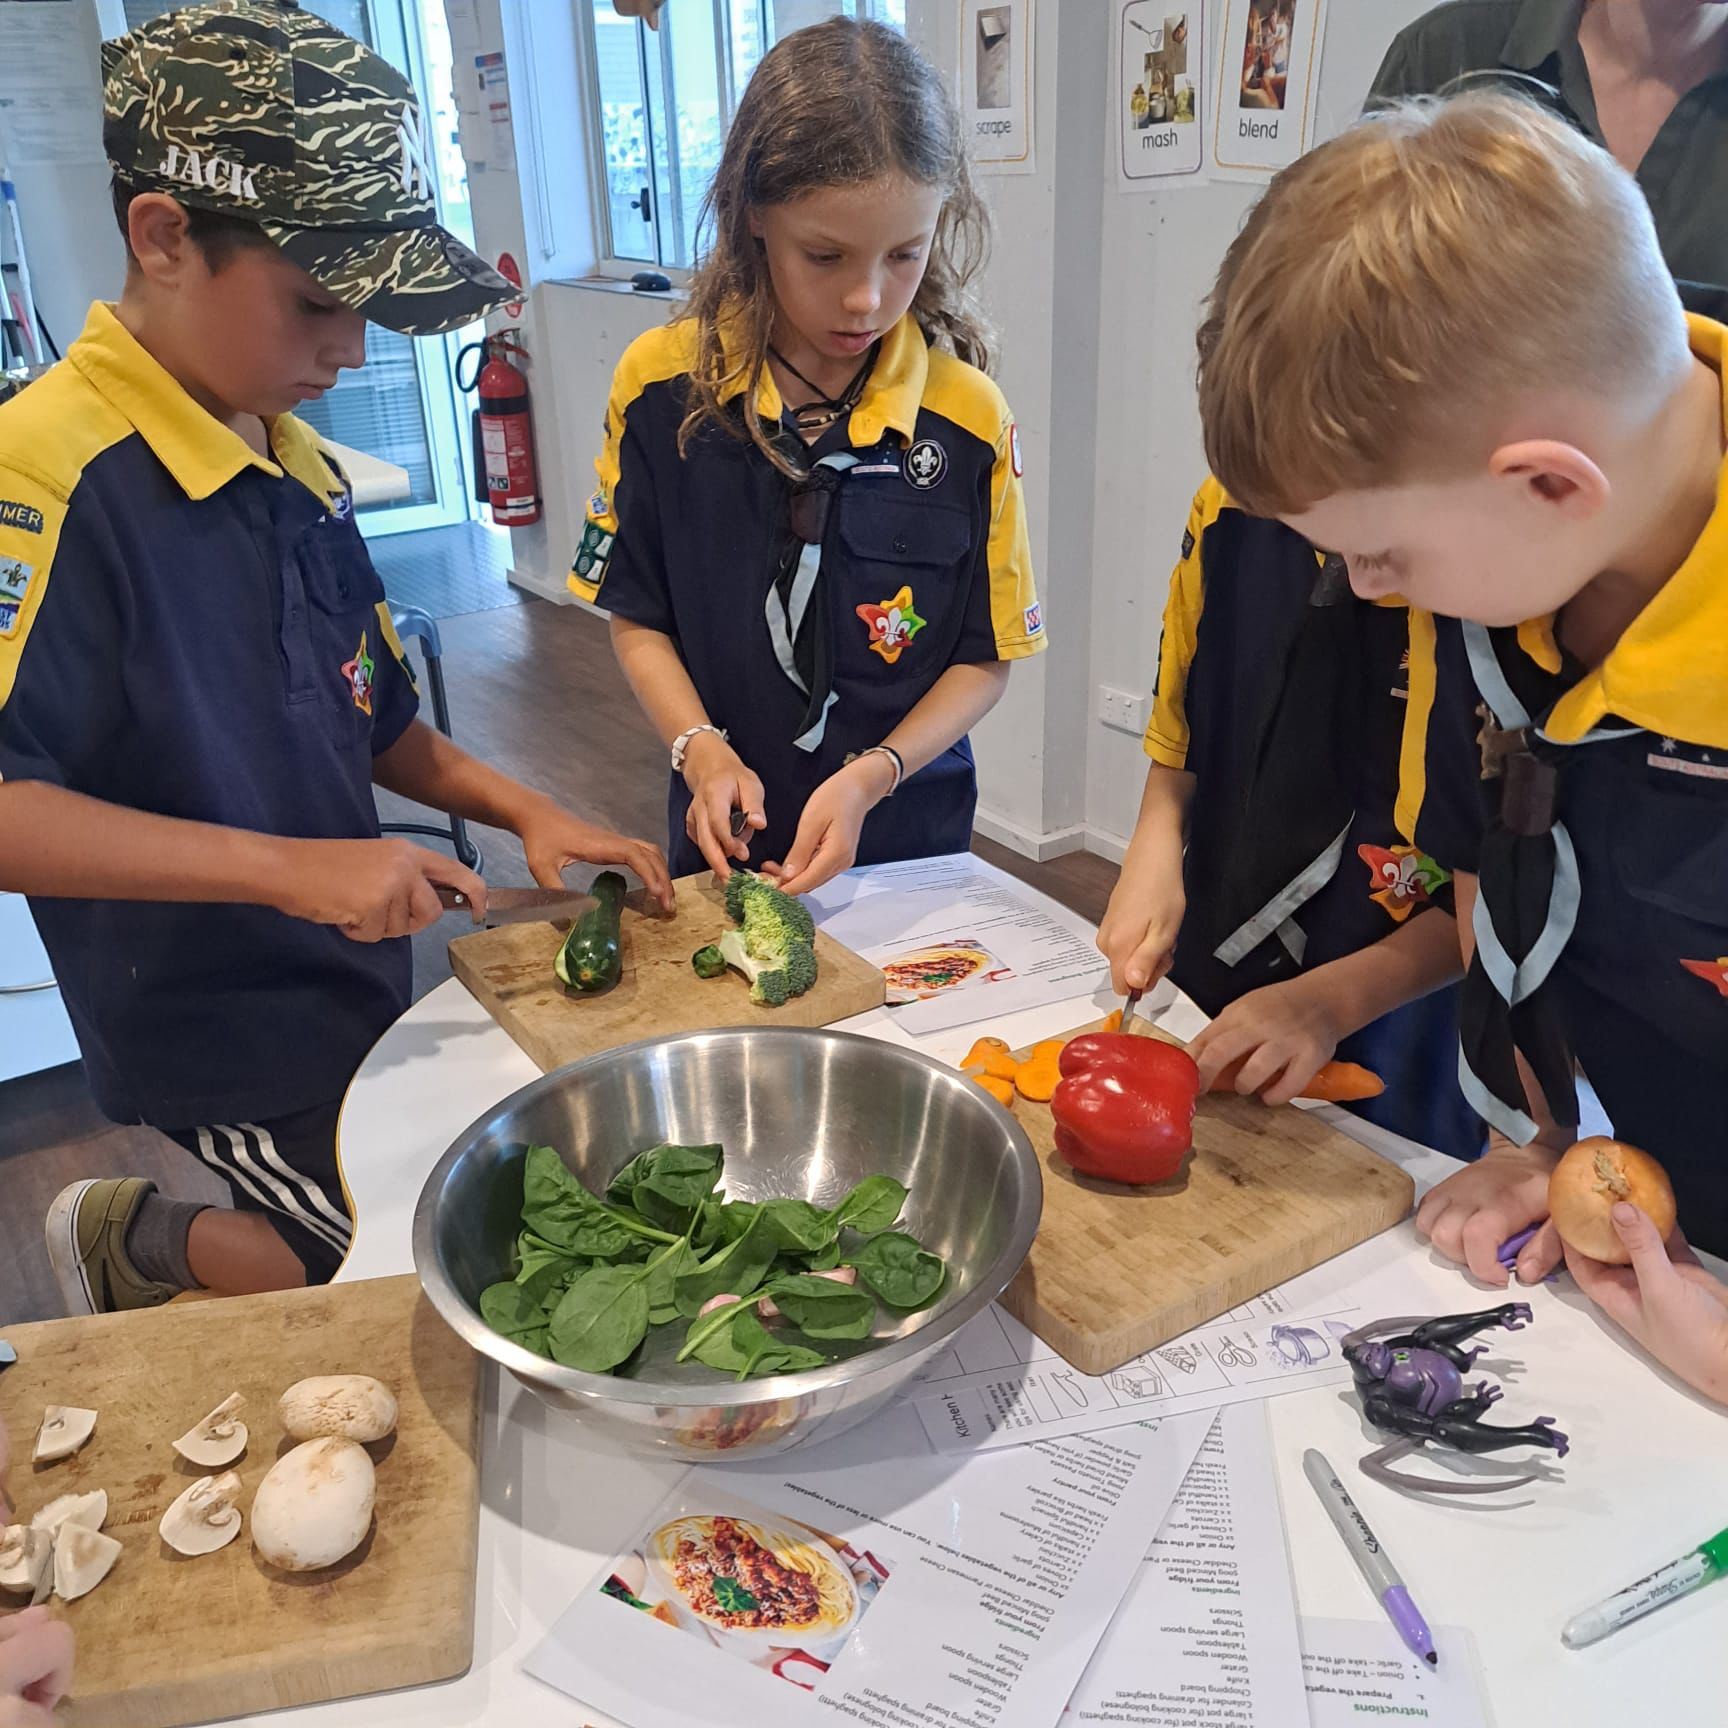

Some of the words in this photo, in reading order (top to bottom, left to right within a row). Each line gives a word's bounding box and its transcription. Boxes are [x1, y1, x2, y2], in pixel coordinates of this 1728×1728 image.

[976, 120, 1011, 138] scrape
[1238, 118, 1278, 140] blend
[1142, 128, 1178, 149] mash
[159, 144, 259, 200] JACK
[0, 503, 42, 527] MER
[946, 1401, 971, 1438] Kitchen
[1061, 1445, 1076, 1455] you
[1064, 1456, 1085, 1468] herbs
[1077, 1469, 1105, 1484] Tomato
[1110, 1465, 1132, 1478] Garlic
[1051, 1475, 1078, 1491] pantry
[782, 1479, 824, 1501] vegetables!
[1025, 1483, 1052, 1500] parsley
[1077, 1485, 1096, 1497] your
[1100, 1487, 1120, 1499] Olive
[823, 1497, 837, 1507] the
[836, 1502, 845, 1510] of
[1034, 1497, 1065, 1513] Broccoli
[1052, 1495, 1066, 1505] like
[1095, 1494, 1117, 1506] From
[845, 1506, 860, 1516] less
[1029, 1503, 1060, 1521] Spinach
[1064, 1509, 1073, 1517] of
[1065, 1501, 1087, 1513] herbs
[1184, 1507, 1218, 1515] Zucchini
[868, 1515, 888, 1526] more
[1073, 1512, 1093, 1524] head
[1087, 1509, 1108, 1521] Fresh
[888, 1523, 902, 1532] use
[1047, 1519, 1085, 1540] Capsicum
[1059, 1516, 1089, 1532] handful
[1167, 1521, 1189, 1529] garlic
[902, 1529, 916, 1538] can
[1018, 1527, 1044, 1542] Celery
[1041, 1528, 1051, 1536] of
[916, 1534, 931, 1545] You
[1043, 1538, 1053, 1546] of
[1050, 1531, 1080, 1547] handful
[1052, 1541, 1075, 1555] stalks
[1218, 1542, 1235, 1550] Any
[1011, 1553, 1033, 1567] garlic
[1037, 1546, 1070, 1563] Zucchini
[918, 1555, 946, 1571] Cheese
[960, 1551, 1003, 1574] vegetables
[1032, 1562, 1041, 1570] of
[1037, 1555, 1066, 1571] Carrots
[1202, 1560, 1237, 1568] Cheddar
[945, 1566, 983, 1586] Parmesan
[1002, 1569, 1017, 1580] the
[1041, 1566, 1067, 1580] Cloves
[1168, 1574, 1193, 1583] fridge
[1017, 1575, 1026, 1584] of
[1026, 1579, 1037, 1588] all
[1034, 1573, 1059, 1587] Onion
[992, 1585, 1021, 1601] Cheese
[1047, 1586, 1065, 1599] Any
[1191, 1585, 1240, 1595] Ingredients
[981, 1591, 1001, 1604] Beef
[978, 1599, 1004, 1615] fridge
[1000, 1599, 1030, 1615] Minced
[1021, 1597, 1055, 1615] Cheddar
[1208, 1608, 1242, 1616] Scissors
[1003, 1609, 1023, 1621] your
[1022, 1618, 1045, 1632] From
[1160, 1624, 1185, 1632] spoon
[1211, 1617, 1243, 1627] Thongs
[993, 1616, 1041, 1641] Ingredients
[1187, 1626, 1218, 1636] serving
[1220, 1629, 1245, 1638] Large
[941, 1642, 966, 1657] spoon
[1195, 1638, 1246, 1649] Tablespoon
[997, 1642, 1030, 1661] Scissors
[1210, 1652, 1247, 1661] Wooden
[965, 1652, 995, 1671] serving
[993, 1651, 1025, 1671] Thongs
[1333, 1656, 1346, 1664] off
[1347, 1658, 1367, 1666] take
[1376, 1660, 1401, 1669] Garlic
[994, 1665, 1019, 1681] Large
[1220, 1664, 1248, 1672] Grater
[1315, 1665, 1329, 1673] the
[1345, 1668, 1366, 1677] Take
[947, 1670, 973, 1686] spoon
[966, 1665, 1013, 1692] Tablespoon
[1225, 1676, 1249, 1684] Knife
[1376, 1671, 1403, 1680] Onion
[972, 1683, 1007, 1703] Wooden
[1179, 1684, 1206, 1692] board
[1207, 1685, 1251, 1695] Chopping
[1337, 1688, 1354, 1696] the
[1355, 1688, 1392, 1700] Prepare
[862, 1686, 900, 1709] spaghetti
[1115, 1689, 1157, 1700] spaghetti
[1158, 1693, 1195, 1703] draining
[817, 1693, 858, 1718] spaghetti)
[842, 1691, 887, 1717] bolognese)
[974, 1697, 1002, 1713] Grater
[1100, 1700, 1149, 1711] bolognese)
[1211, 1698, 1252, 1707] Colander
[899, 1703, 934, 1724] draining
[925, 1702, 950, 1718] board
[1150, 1704, 1186, 1714] cooking
[1188, 1707, 1204, 1715] (for
[1206, 1708, 1221, 1716] pot
[1223, 1709, 1246, 1718] large
[1353, 1704, 1428, 1716] Instructions
[972, 1709, 996, 1724] Knife
[1078, 1711, 1124, 1721] spaghetti)
[1125, 1714, 1161, 1723] cooking
[1164, 1716, 1179, 1724] (for
[1181, 1717, 1196, 1725] pot
